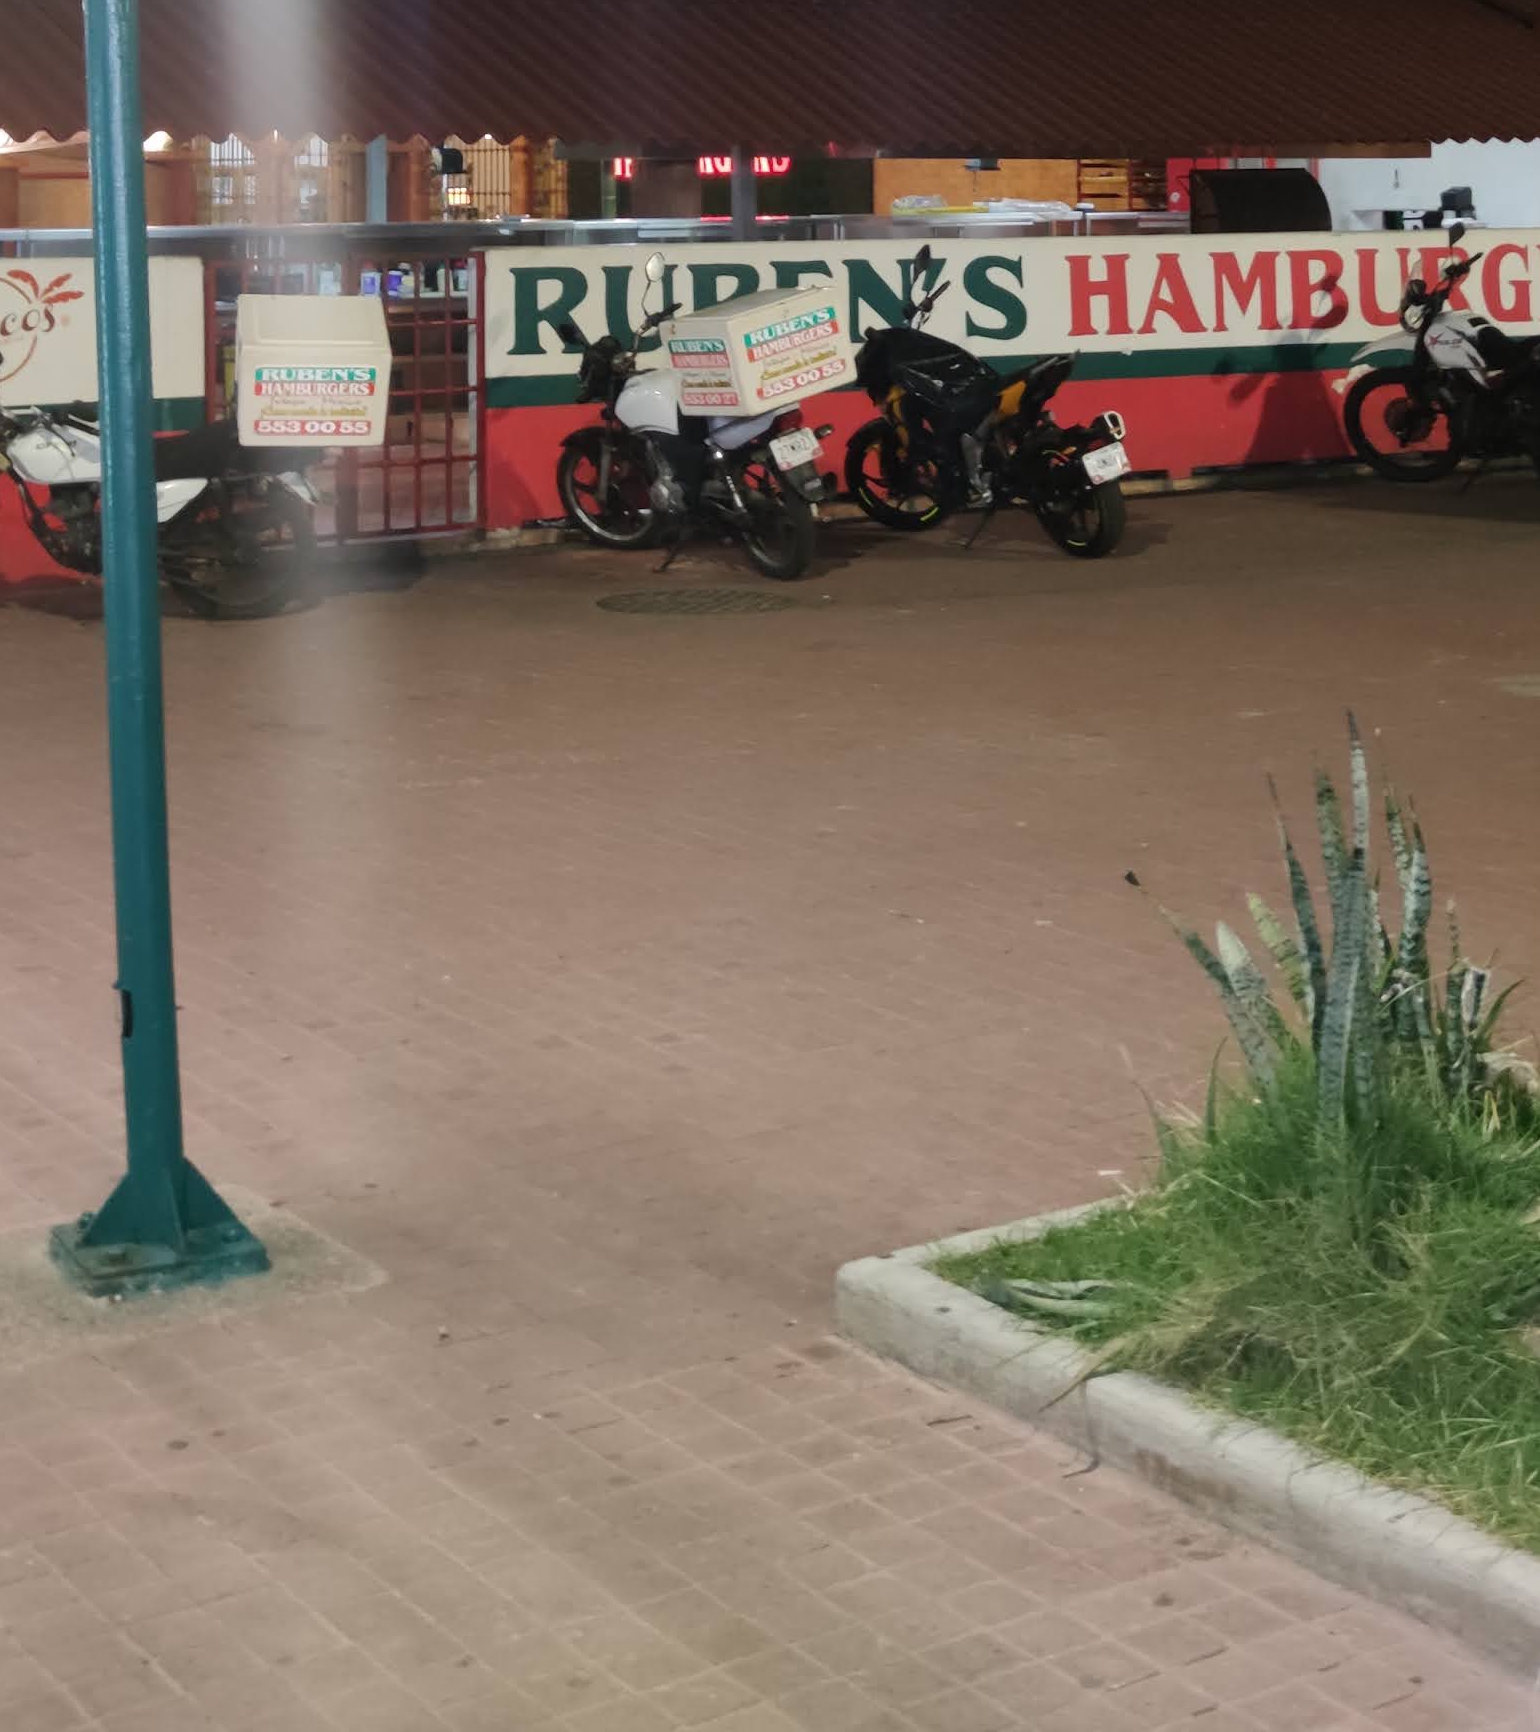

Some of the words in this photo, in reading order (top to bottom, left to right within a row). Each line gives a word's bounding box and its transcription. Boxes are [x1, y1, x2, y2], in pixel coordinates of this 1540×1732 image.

[749, 308, 831, 345] RUBEN'S
[753, 323, 833, 360] HAMBURGERS
[260, 369, 372, 381] RUBEN'S
[261, 382, 370, 396] HAMBURGERS
[763, 378, 796, 397] 553
[258, 421, 301, 434] 553
[304, 421, 336, 434] 00
[339, 421, 369, 434] 55
